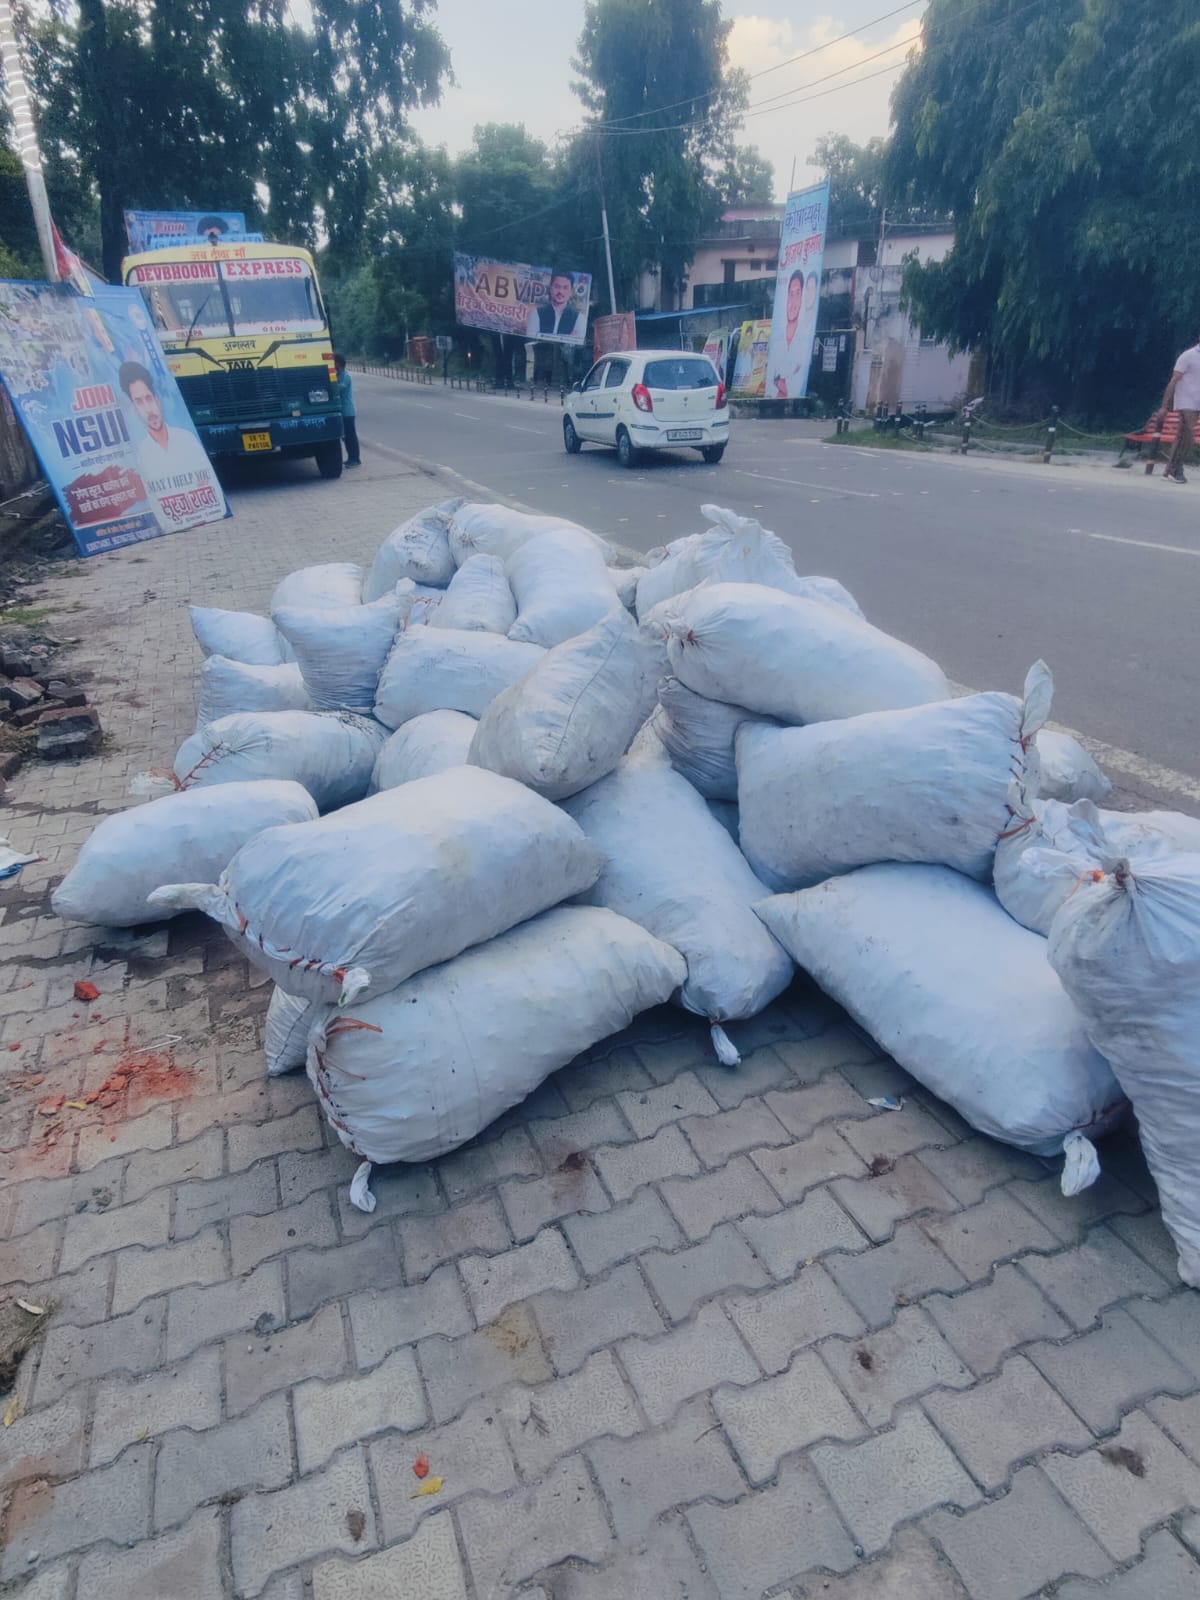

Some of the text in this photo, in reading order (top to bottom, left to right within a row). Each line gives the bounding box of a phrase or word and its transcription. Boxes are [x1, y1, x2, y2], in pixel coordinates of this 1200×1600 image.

[136, 260, 303, 283] DEVBHOOMI EXPRESS
[475, 273, 547, 304] ABVP
[226, 360, 254, 370] TATA
[72, 384, 116, 411] JOIN
[53, 409, 130, 458] NSUI
[147, 479, 166, 492] MAY
[172, 471, 193, 489] HELP
